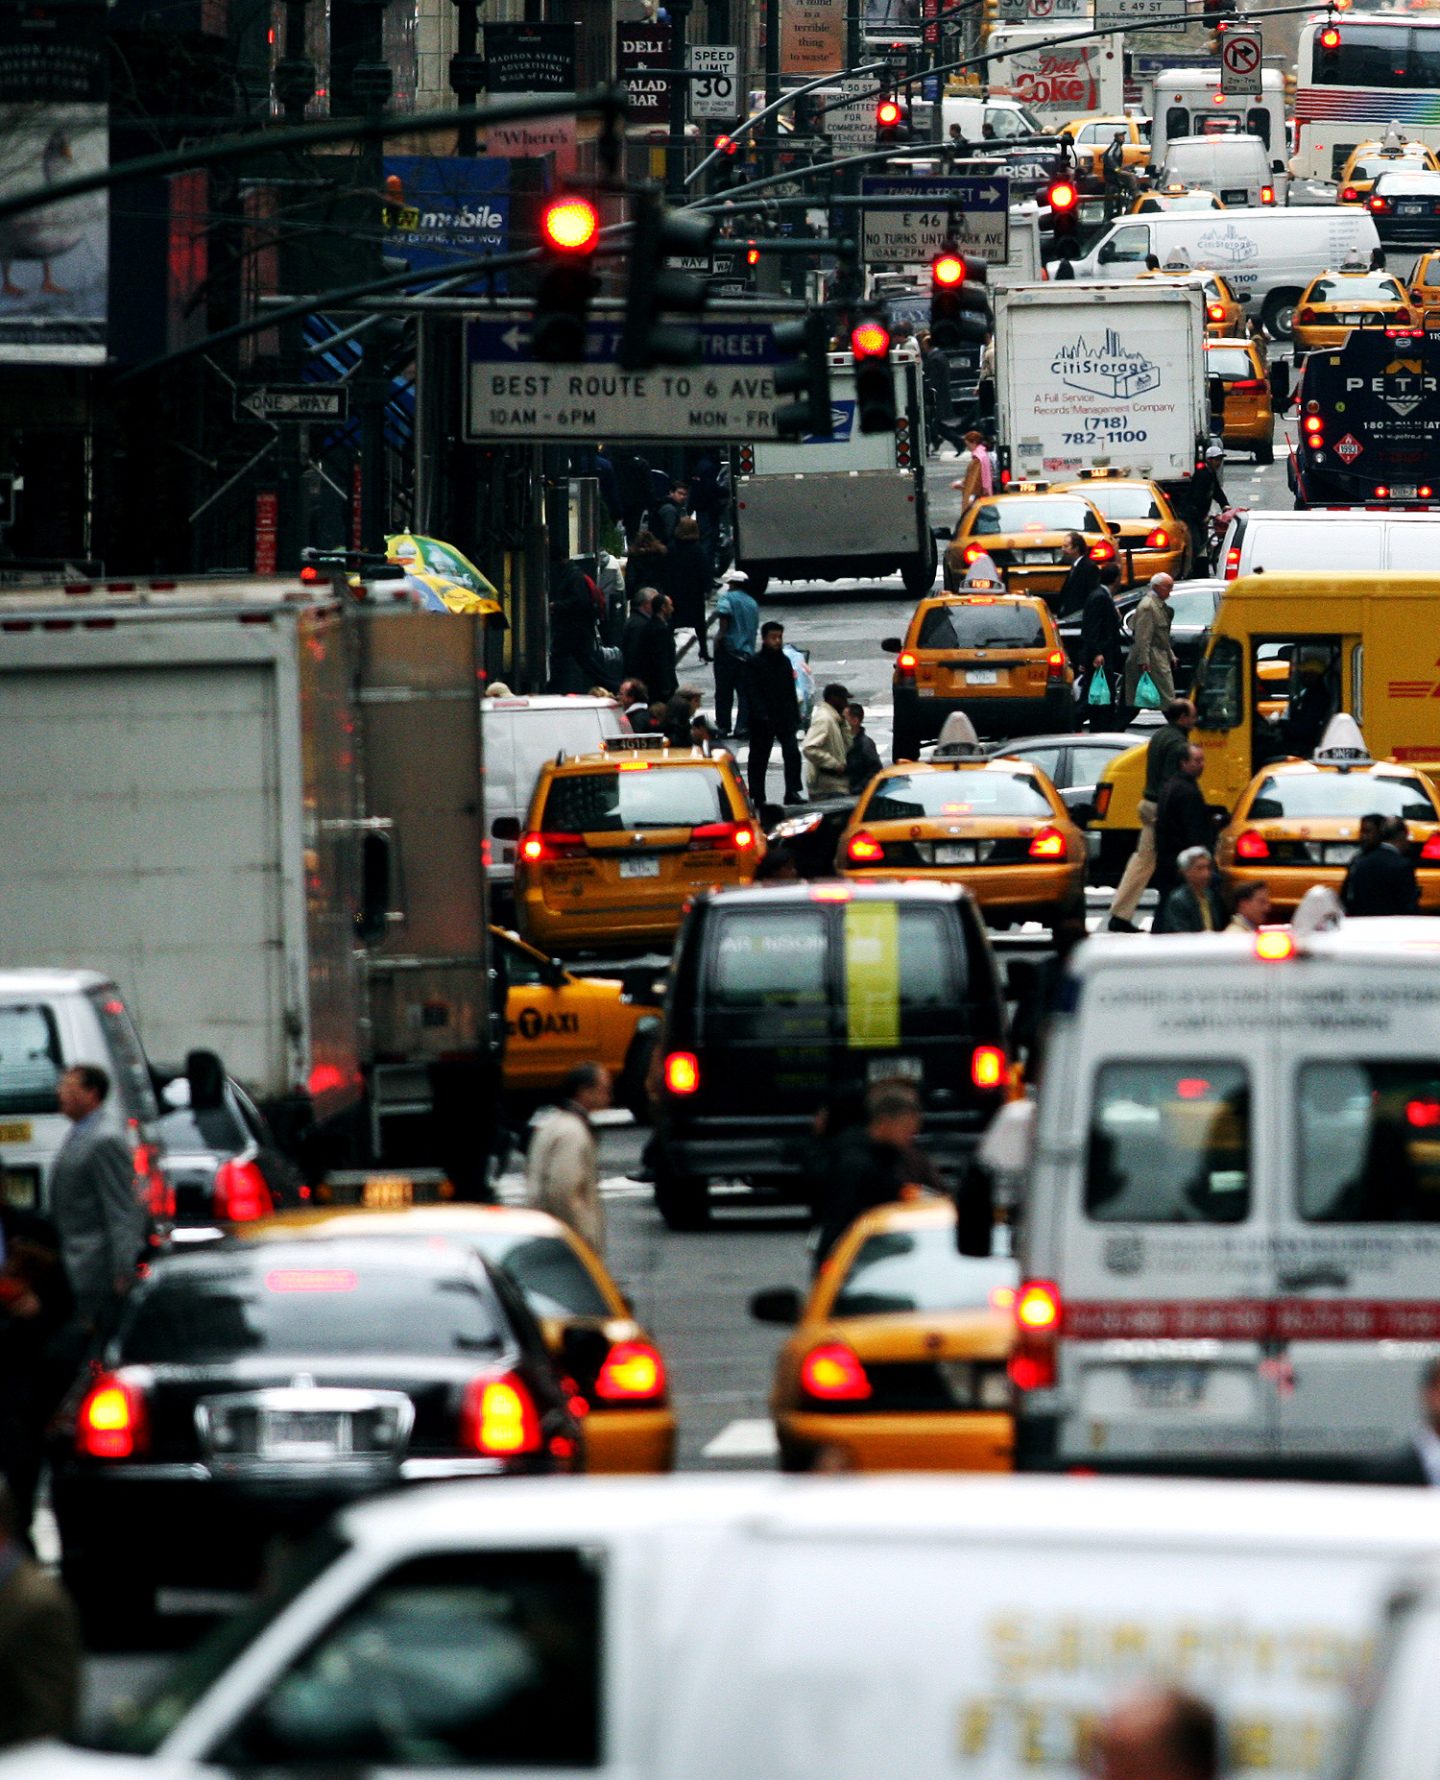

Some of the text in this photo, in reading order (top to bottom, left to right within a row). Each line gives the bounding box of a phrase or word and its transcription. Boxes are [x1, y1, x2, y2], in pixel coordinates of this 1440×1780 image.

[1119, 2, 1162, 12] E 49 ST
[794, 23, 831, 33] terrible
[622, 41, 664, 53] DELI
[799, 38, 824, 49] thing
[694, 51, 735, 61] SPEED
[790, 52, 799, 61] to
[699, 63, 729, 73] LIMIT
[1039, 54, 1080, 76] Diet
[621, 79, 668, 92] SALAD
[695, 76, 732, 98] 30
[1016, 74, 1085, 104] Coke
[629, 95, 658, 107] BAR
[844, 113, 861, 121] FOR
[903, 214, 941, 228] E 46
[866, 234, 881, 245] NO
[885, 234, 918, 246] TURNS
[921, 234, 948, 246] UNTI
[984, 233, 1004, 246] AVE
[682, 256, 704, 268] WAY
[699, 335, 767, 356] TREET
[1050, 360, 1150, 377] CitiStorage
[492, 376, 775, 398] BEST ROUTE TO 6 AVE
[252, 396, 332, 411] ONE WAY
[1034, 392, 1095, 403] A Full Service
[1034, 402, 1175, 416] Records Management Company
[490, 409, 596, 425] 10AM 6PM
[689, 411, 778, 427] MON FRI
[1084, 416, 1128, 430] (718)
[1062, 430, 1147, 445] 782-1100
